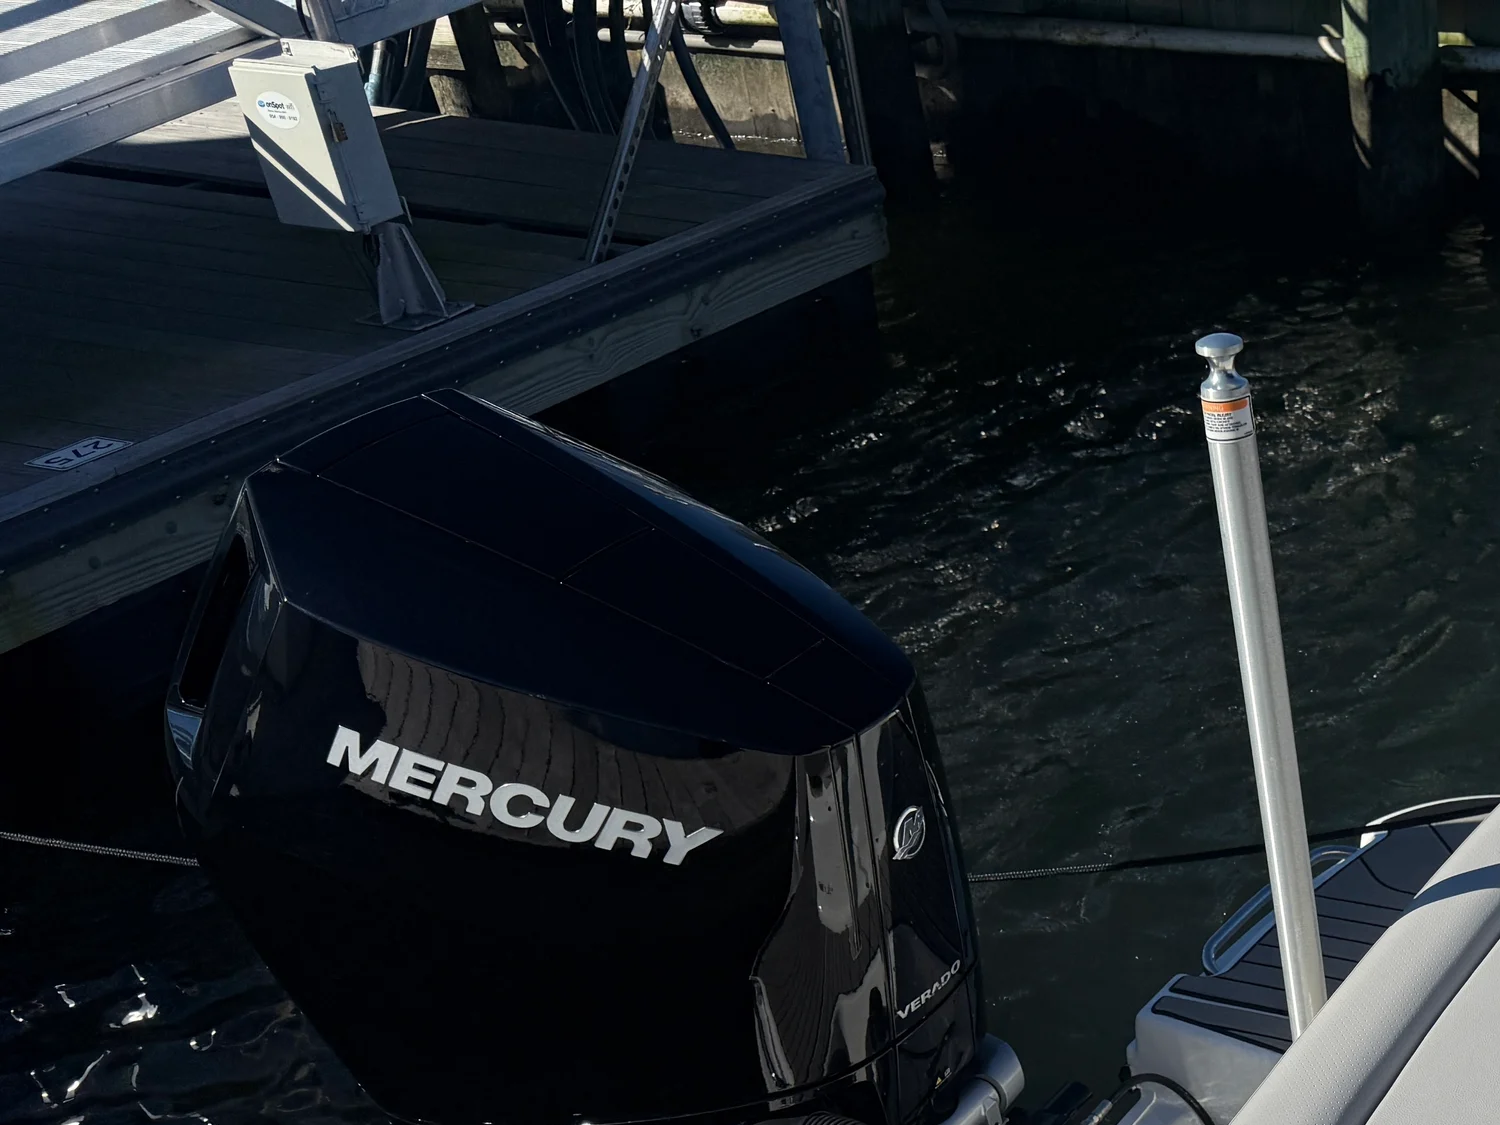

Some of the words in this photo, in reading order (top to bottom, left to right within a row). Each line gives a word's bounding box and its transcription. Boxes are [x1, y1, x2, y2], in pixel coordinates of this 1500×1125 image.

[44, 440, 113, 466] 275
[326, 724, 724, 866] MERCURY
[897, 959, 961, 1021] VERADO
